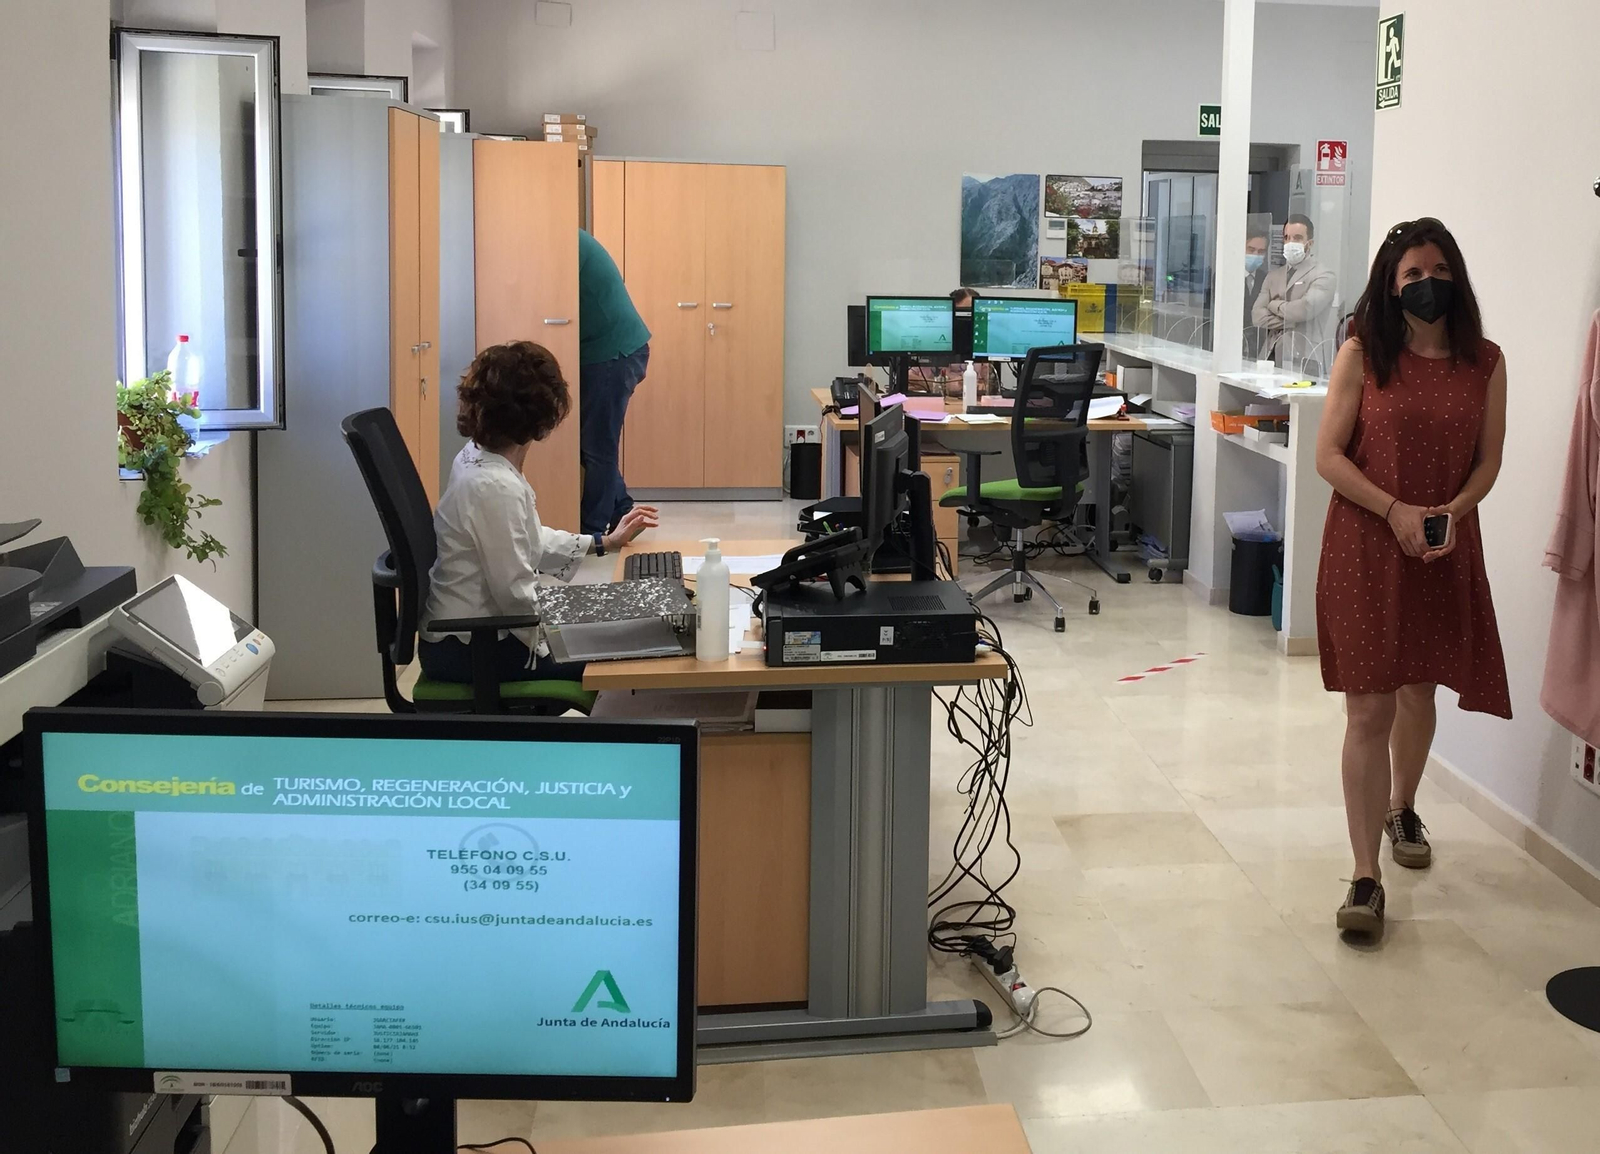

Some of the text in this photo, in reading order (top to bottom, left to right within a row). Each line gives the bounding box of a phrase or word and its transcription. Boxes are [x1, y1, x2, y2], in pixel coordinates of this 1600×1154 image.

[1378, 86, 1399, 101] SALIDA
[1317, 174, 1344, 185] EXTINTOR
[77, 774, 632, 799] Consejería de TURISMO, REGENERACIÓN, JUSTICIA y
[272, 793, 511, 810] ADMINISTRACIÓN LOCAL
[426, 848, 571, 861] TELÉFONO C.S.U.
[450, 864, 547, 876] 955 04 09 55
[463, 880, 539, 893] (34 09 55)
[348, 913, 653, 927] correo-e: csu.ius@juntadeandalucia.es
[537, 1018, 671, 1029] Junta de Andalucía
[351, 1081, 384, 1093] AOC
